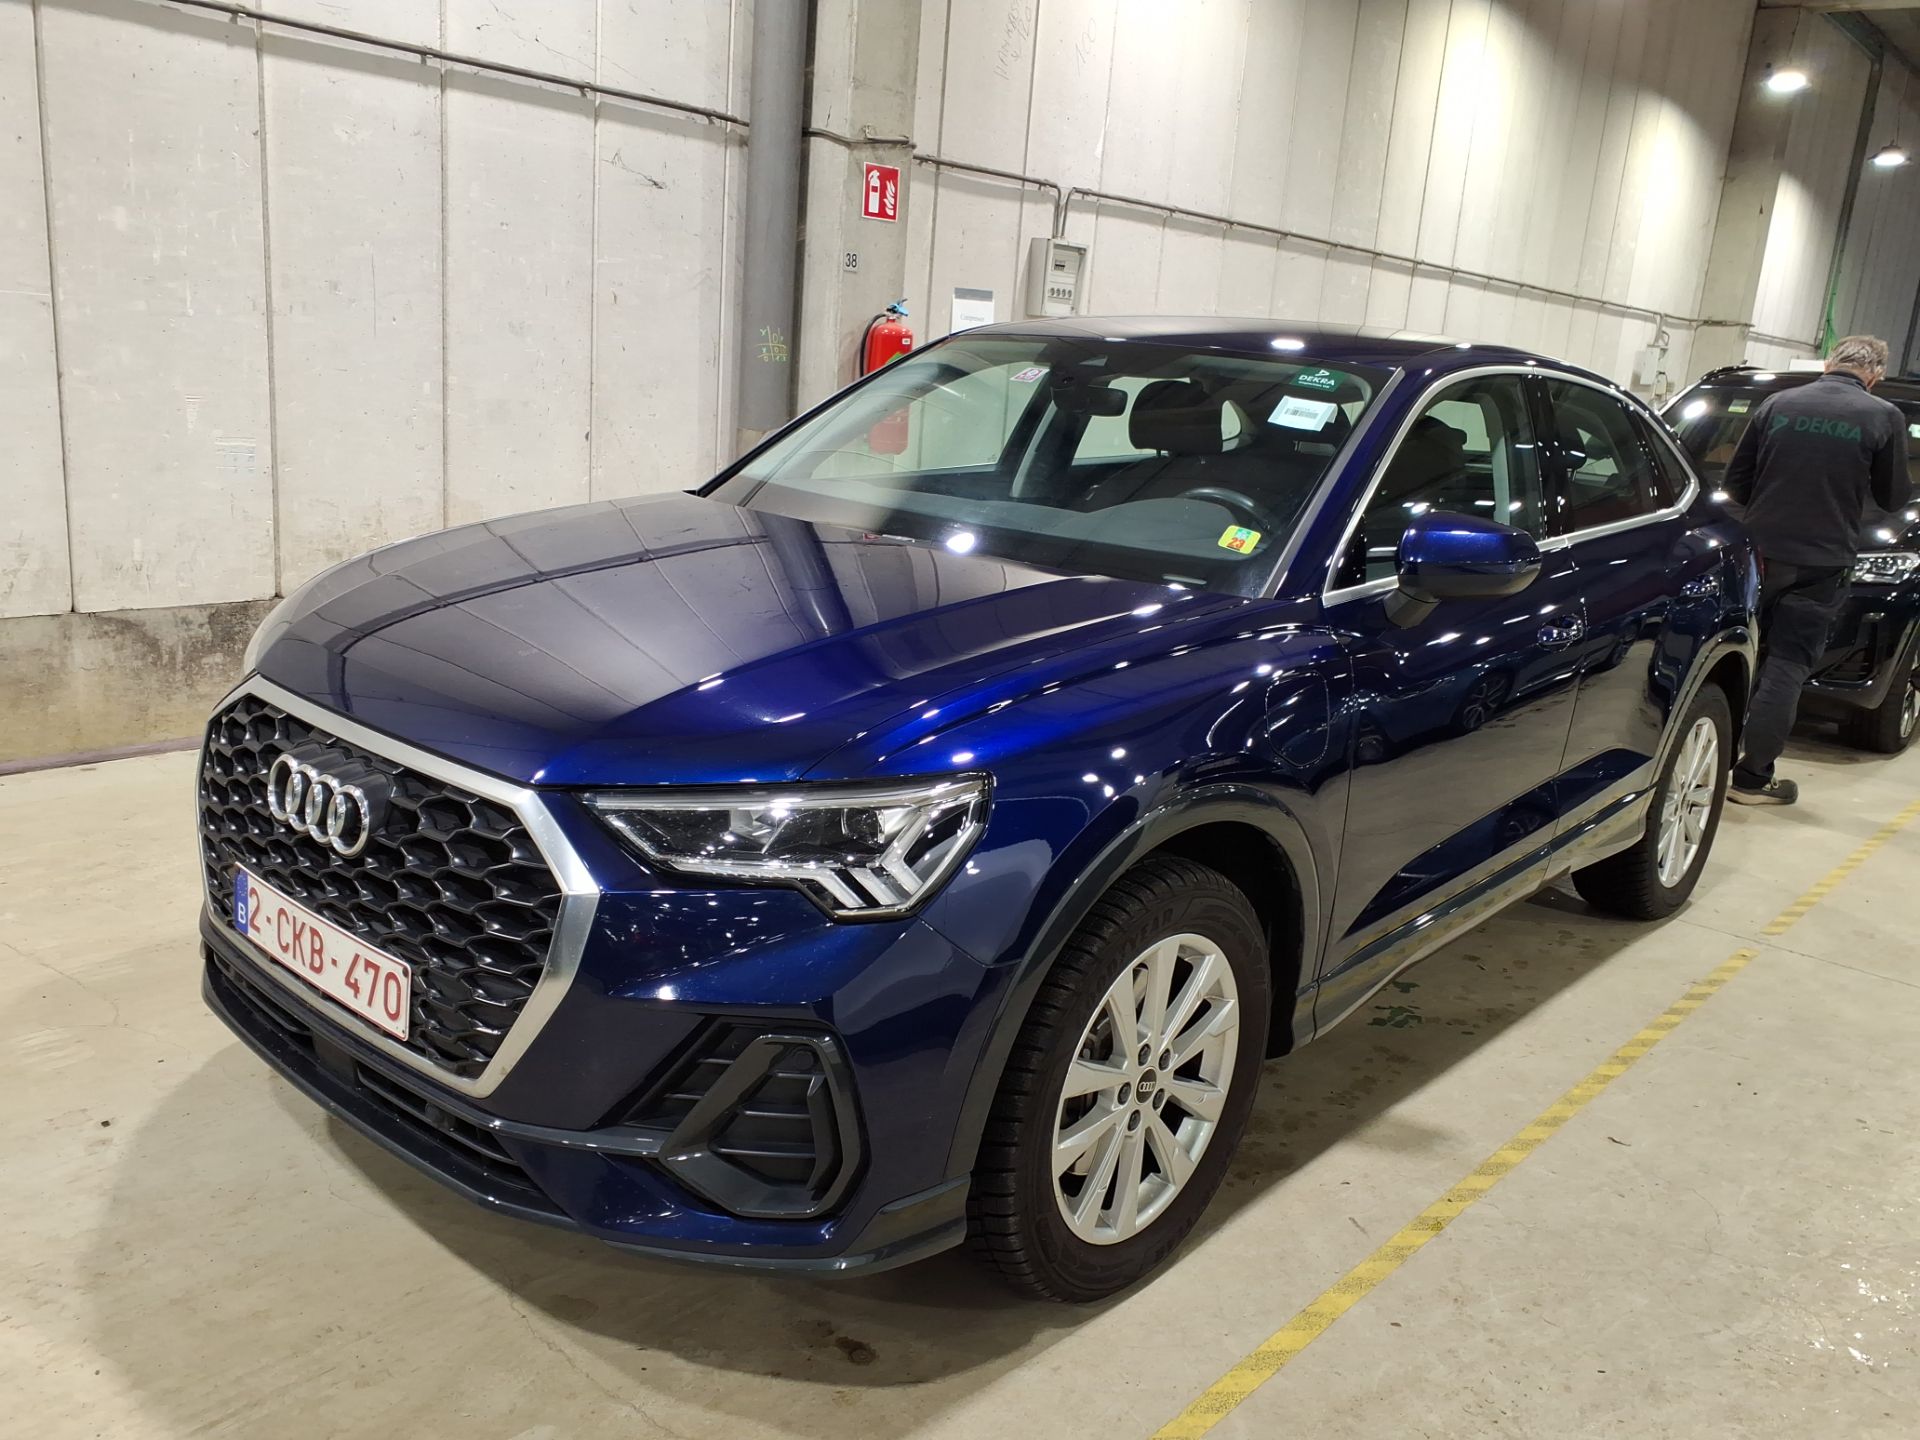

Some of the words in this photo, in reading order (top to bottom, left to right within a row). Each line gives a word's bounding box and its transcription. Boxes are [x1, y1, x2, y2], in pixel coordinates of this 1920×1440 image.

[845, 253, 857, 268] 38
[1298, 374, 1335, 386] DEKRA
[1794, 415, 1861, 443] DEKRA
[238, 902, 247, 925] B
[249, 887, 402, 1021] 2-CKB-470
